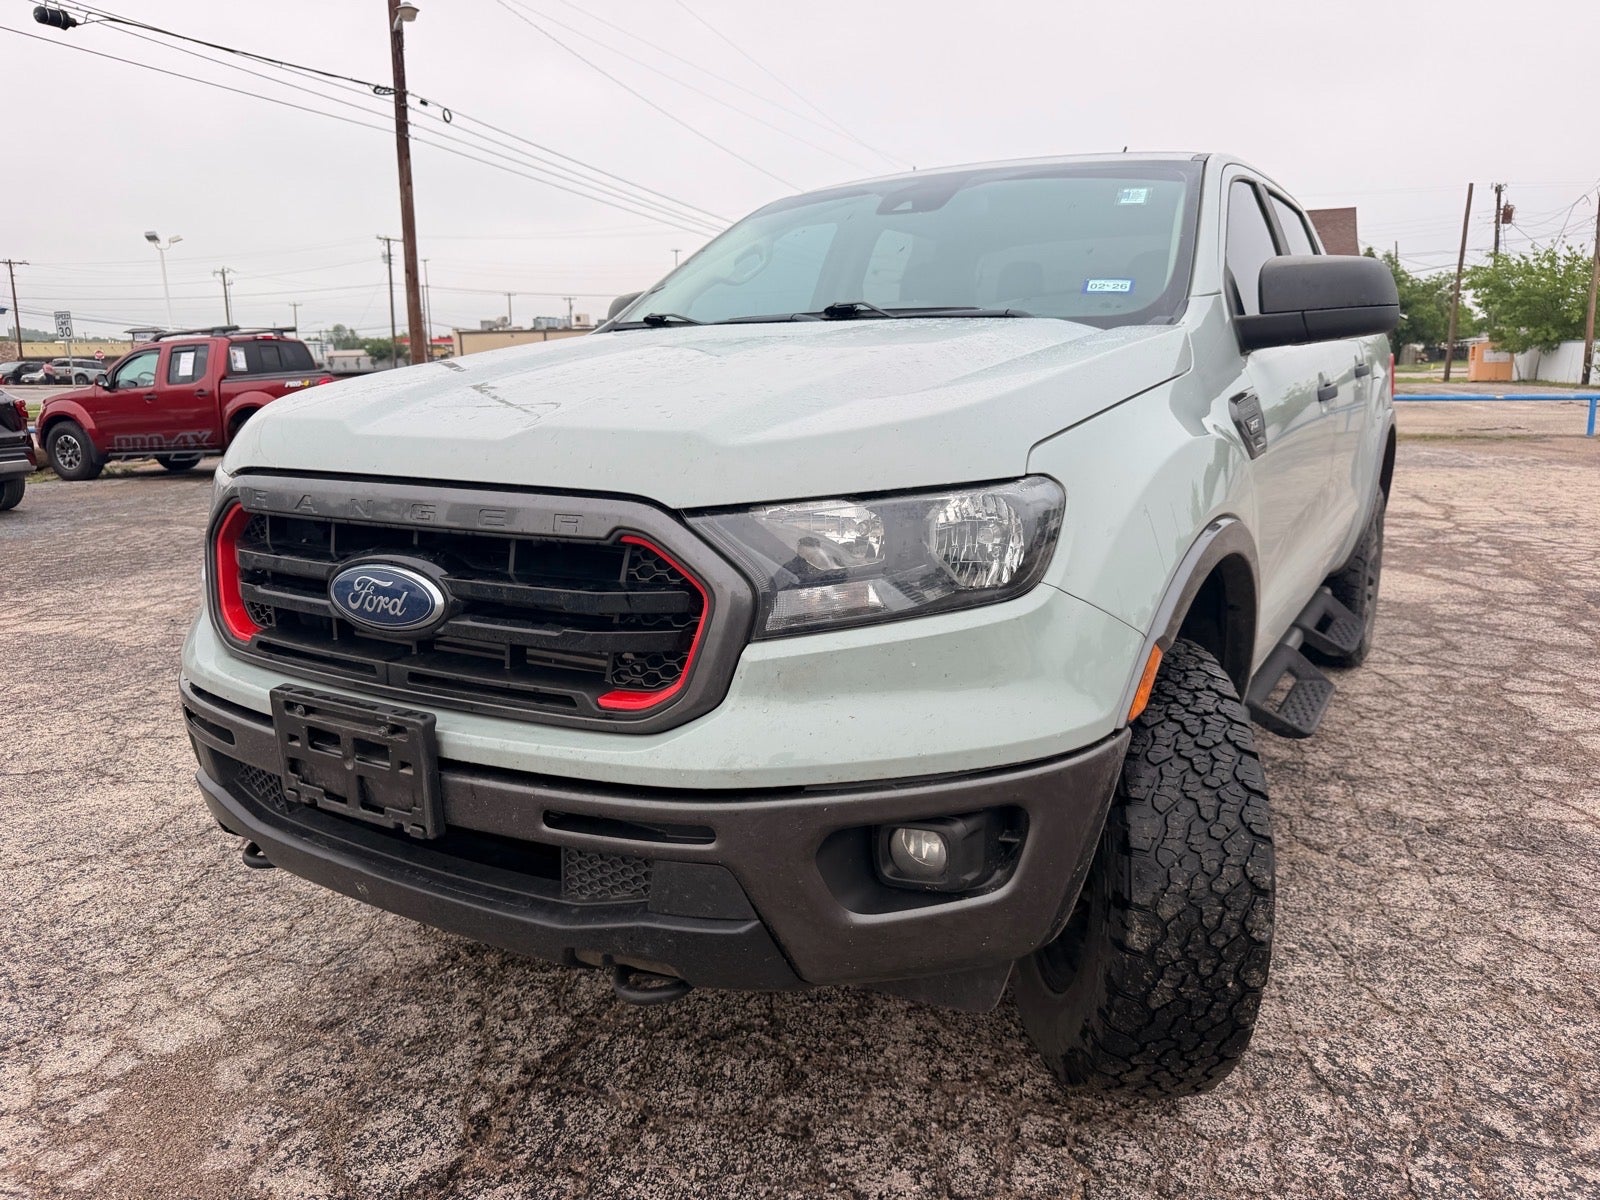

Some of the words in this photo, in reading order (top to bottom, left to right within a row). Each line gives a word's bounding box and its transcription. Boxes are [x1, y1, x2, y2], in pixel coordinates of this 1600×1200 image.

[58, 326, 72, 338] 30
[251, 488, 585, 534] RANGER
[347, 575, 408, 617] Ford
